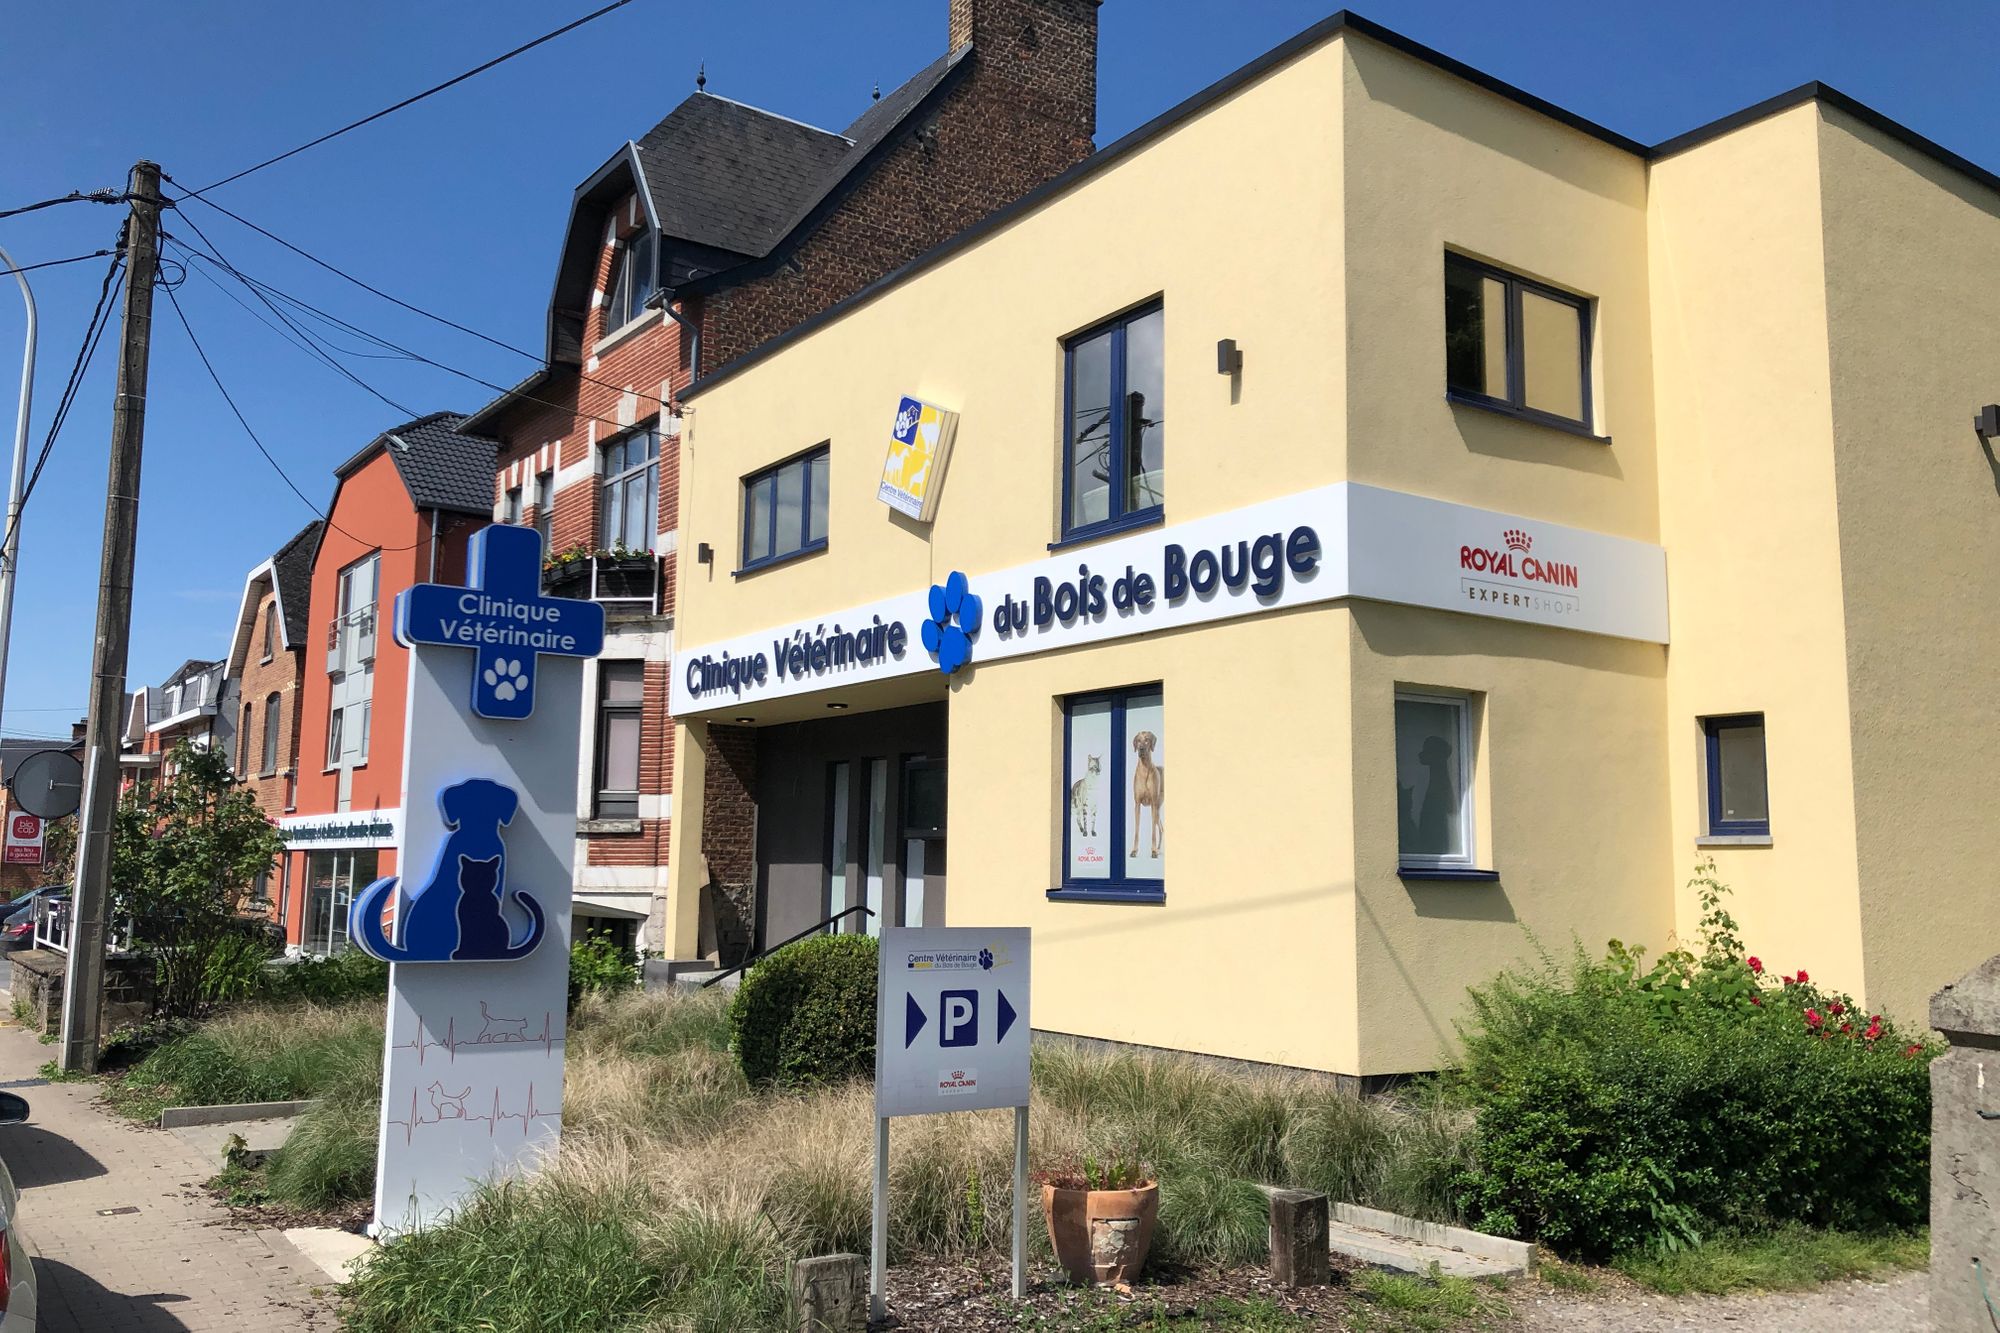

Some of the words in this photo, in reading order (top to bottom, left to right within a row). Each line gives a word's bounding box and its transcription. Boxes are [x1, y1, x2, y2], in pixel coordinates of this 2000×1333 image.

[993, 594, 1028, 634] du
[1034, 564, 1105, 626] Bois
[1112, 565, 1155, 610] de
[1165, 525, 1321, 600] Bouge
[1460, 545, 1518, 578] ROYAL
[1522, 557, 1578, 589] CANIN
[458, 593, 561, 624] Clinique
[440, 618, 576, 651] Vétérinaire
[686, 650, 767, 695] Clinique
[774, 614, 906, 678] Vétérinaire
[908, 953, 934, 962] Centre
[936, 952, 977, 962] Vétérinaire
[944, 996, 974, 1041] P
[958, 1079, 977, 1087] CANIN
